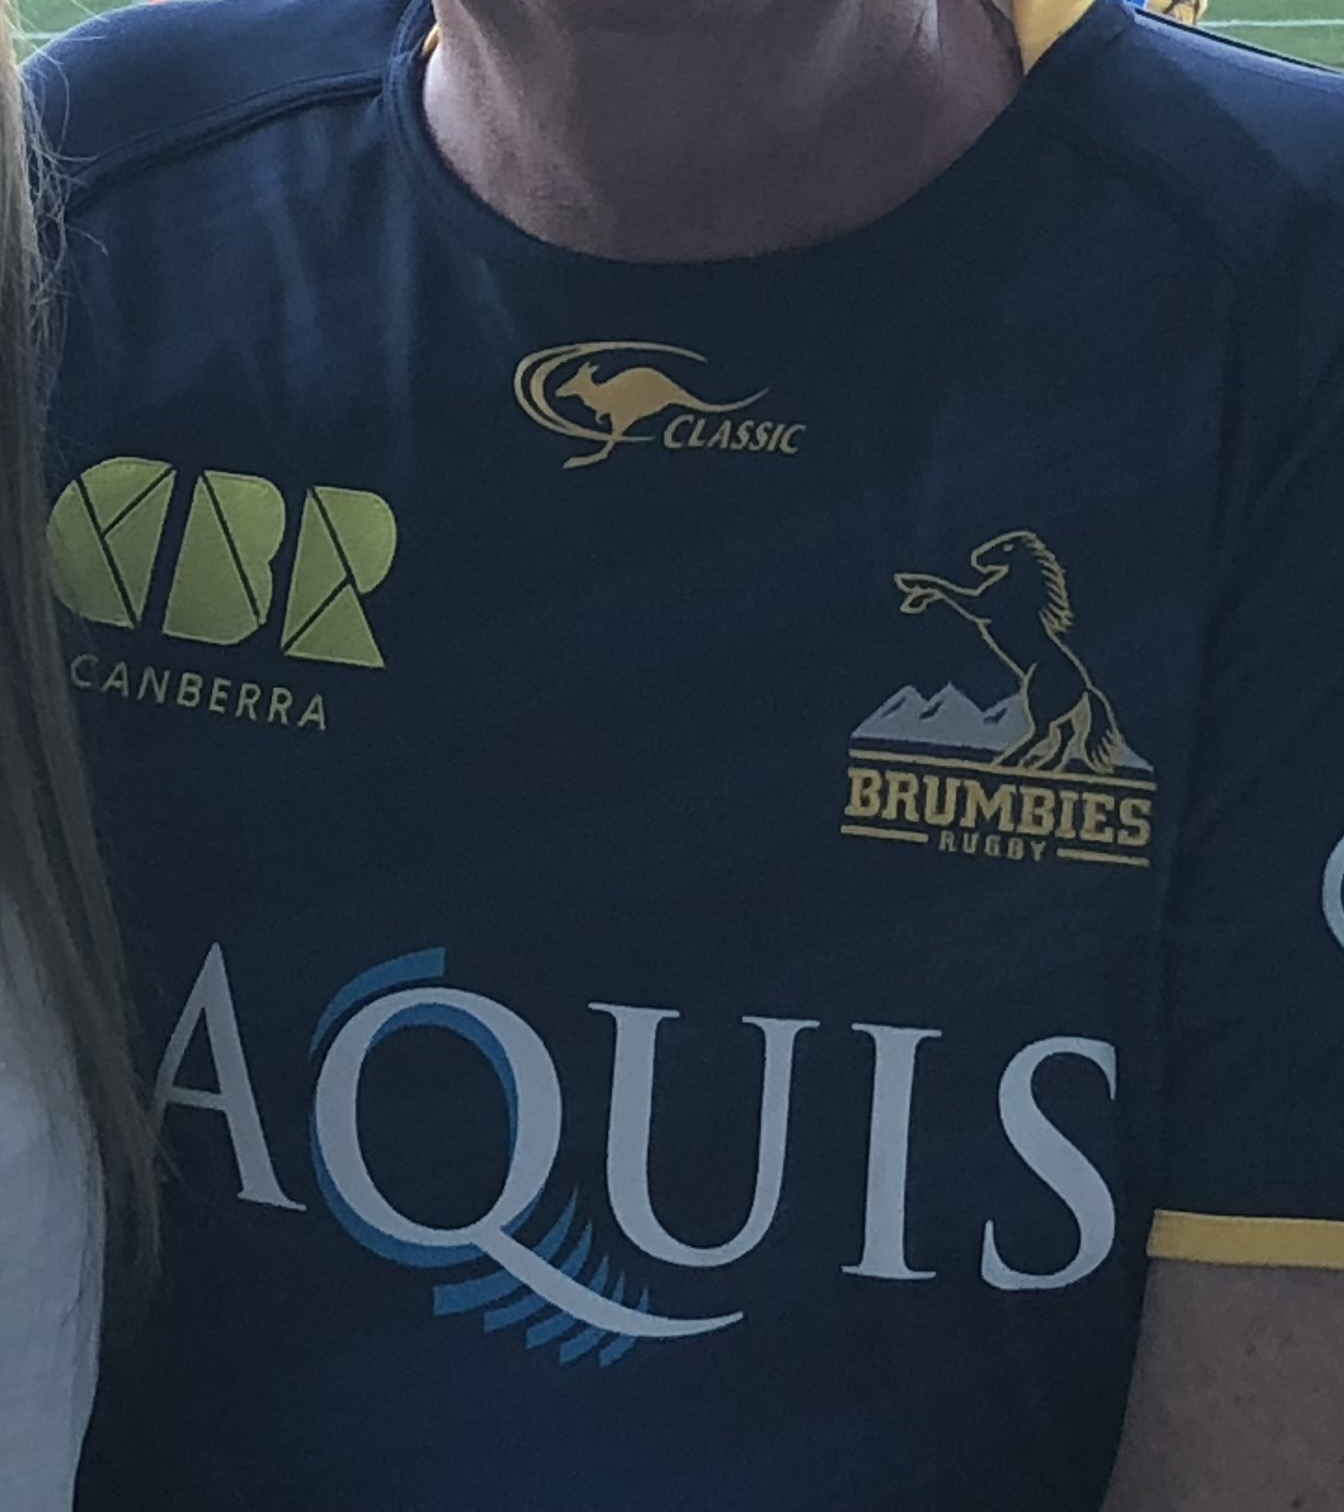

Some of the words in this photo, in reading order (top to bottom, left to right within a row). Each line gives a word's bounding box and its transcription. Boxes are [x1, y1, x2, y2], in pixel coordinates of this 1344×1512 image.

[664, 414, 806, 454] CLASSIC
[45, 456, 397, 669] CBR
[70, 654, 327, 731] CANBERRA
[844, 766, 1153, 846] BRUMBIES
[939, 829, 1047, 862] RUGBY
[155, 941, 1117, 1338] AQUIS
